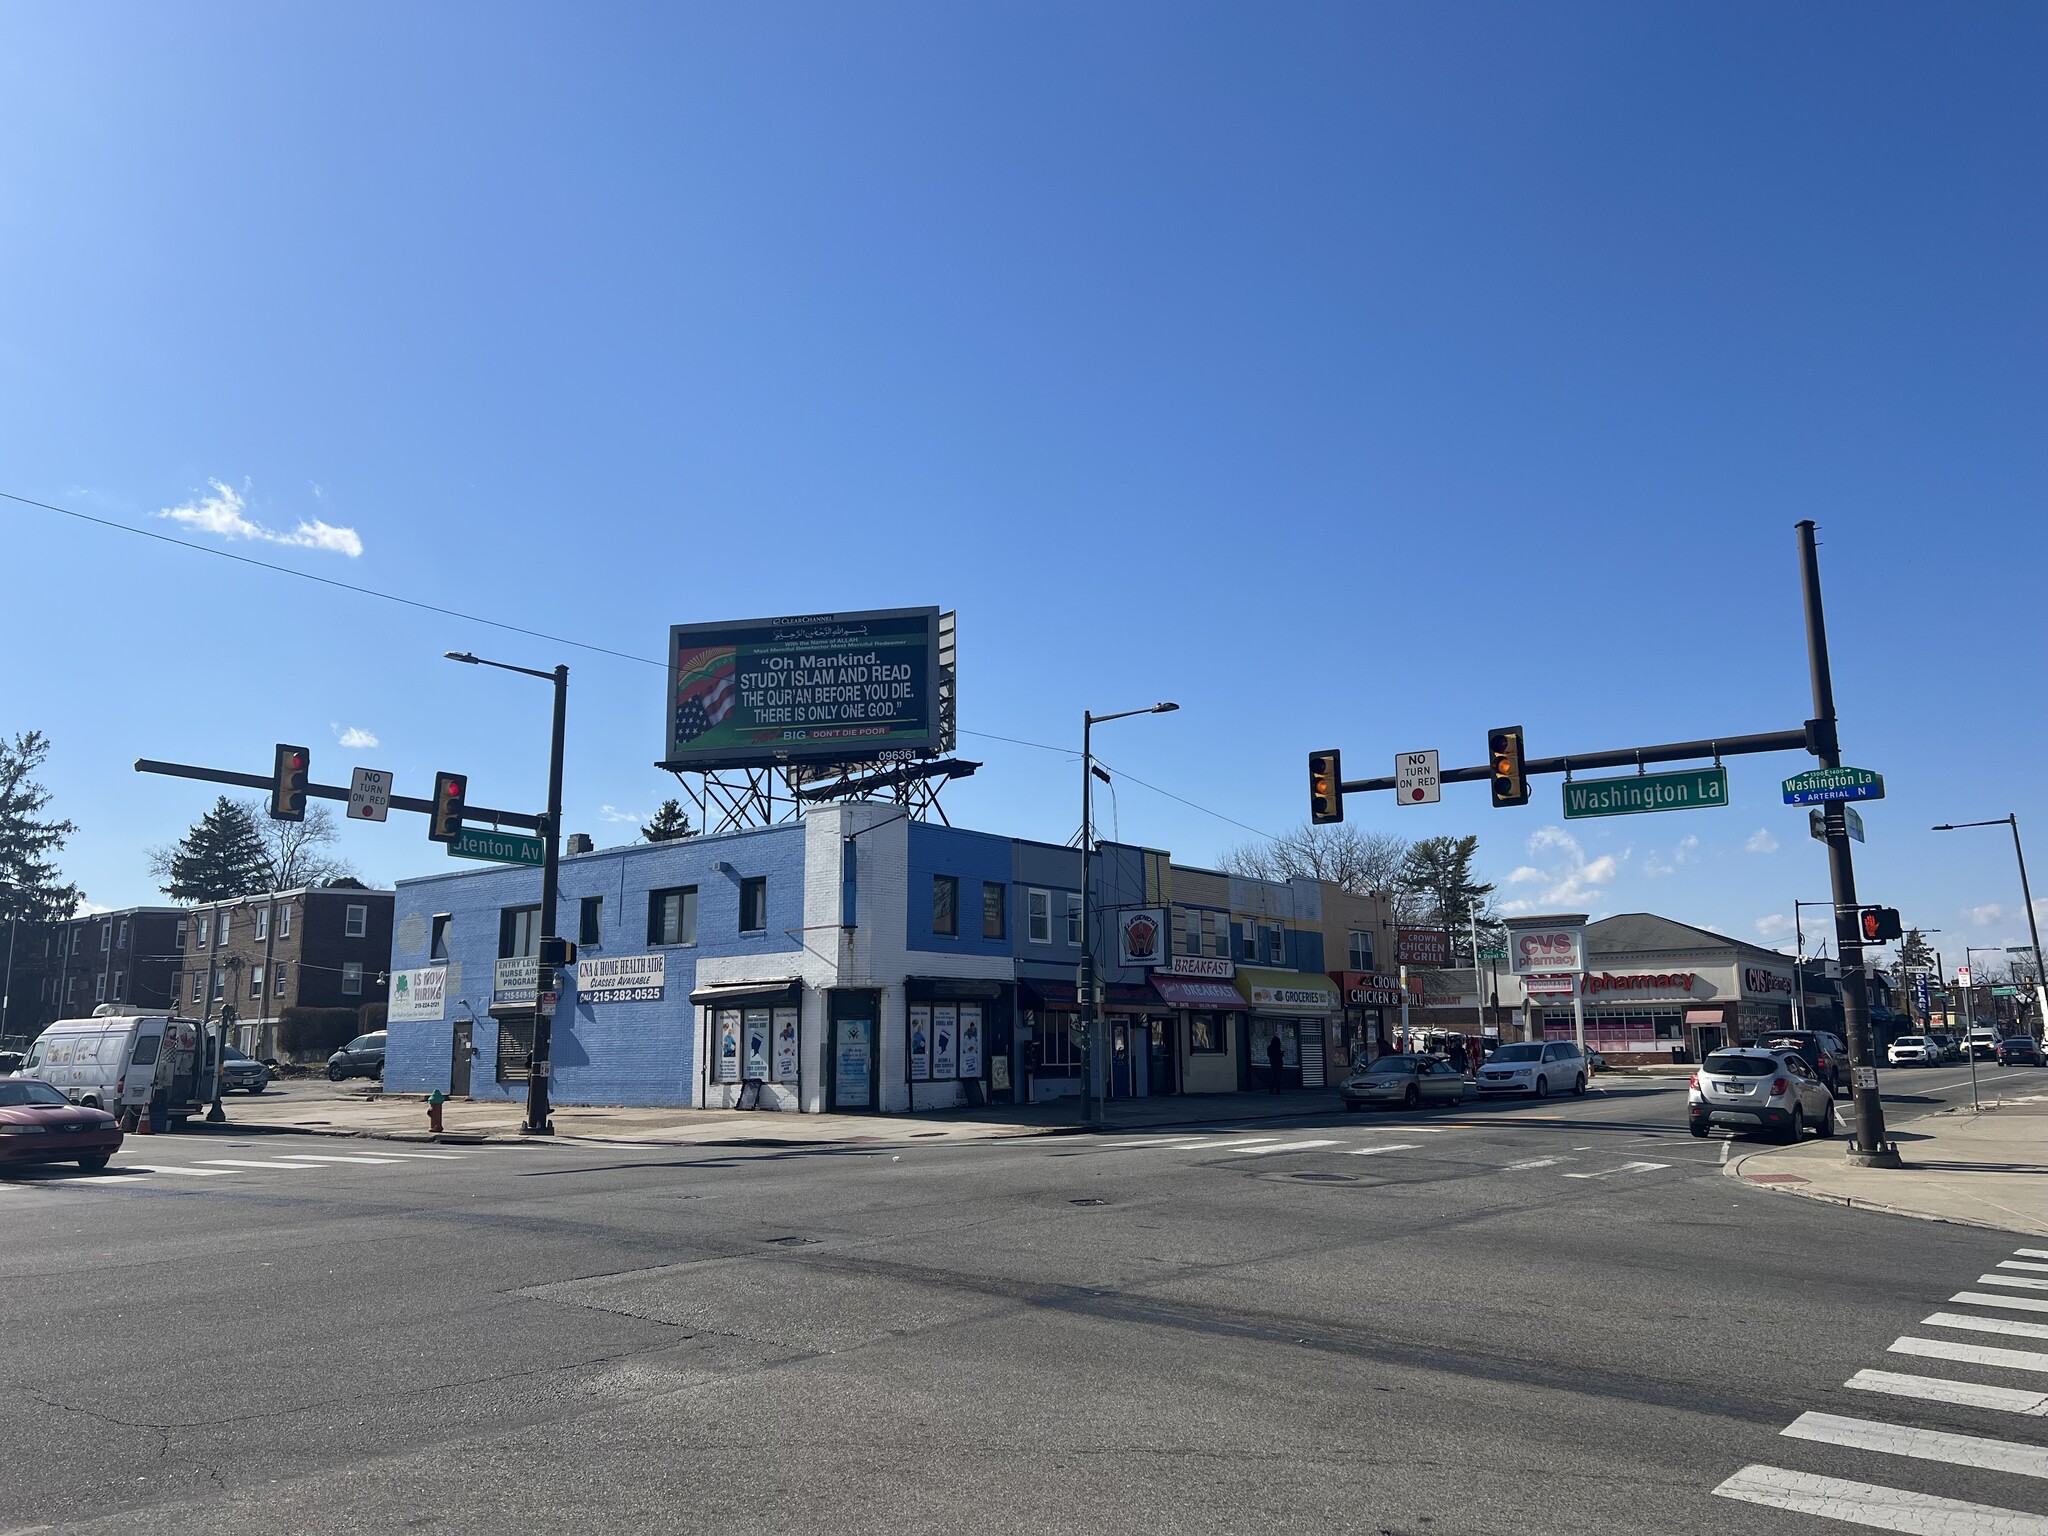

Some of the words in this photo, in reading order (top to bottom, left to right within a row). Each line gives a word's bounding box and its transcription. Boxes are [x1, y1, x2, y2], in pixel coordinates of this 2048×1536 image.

[800, 652, 881, 669] Mankind.
[740, 671, 787, 689] STUDY
[791, 668, 835, 687] ISLAM
[838, 666, 868, 684] AND
[872, 664, 911, 682] READ
[741, 691, 764, 707] THE
[766, 688, 812, 706] QUR'AN
[815, 685, 861, 703] BEFORE
[863, 684, 888, 700] YOU
[891, 682, 914, 698] DIE.
[754, 708, 792, 723] THERE
[794, 707, 806, 721] IS
[808, 705, 838, 720] ONLY
[840, 703, 865, 719] ONE
[783, 731, 806, 740] BIG
[813, 729, 841, 738] DON'T
[842, 728, 857, 736] DIE
[859, 727, 885, 736] POOR
[878, 750, 916, 761] 096361
[1408, 754, 1426, 765] NO
[364, 772, 381, 783] NO
[1405, 766, 1430, 777] TURN
[360, 783, 383, 794] TURN
[1400, 779, 1412, 788] ON
[1418, 777, 1436, 786] RED
[1785, 774, 1855, 792] Washington
[1859, 772, 1872, 784] La
[352, 793, 365, 802] ON
[369, 795, 386, 805] RED
[1570, 783, 1688, 808] Washington
[1698, 778, 1720, 799] La
[1793, 794, 1801, 802] S
[1807, 790, 1850, 801] ARTERIAL
[1857, 787, 1866, 795] N
[521, 843, 539, 860] Av
[1408, 934, 1437, 942] CROWN
[1520, 933, 1571, 955] CVS
[1399, 943, 1445, 952] CHICKEN
[1399, 951, 1409, 960] &
[1413, 952, 1445, 962] GRILL
[1519, 955, 1576, 968] pharmacy
[499, 961, 521, 973] ENTRY
[522, 959, 539, 971] LEVE
[580, 962, 593, 977] CNA
[594, 962, 599, 976] &
[600, 961, 619, 976] HOME
[620, 958, 646, 974] HEALTH
[646, 957, 664, 972] AIDE
[1174, 958, 1229, 975] BREAKFAST
[413, 973, 422, 986] IS
[423, 971, 443, 986] NOW
[500, 969, 523, 978] NURSE
[525, 968, 538, 977] AID
[590, 978, 616, 988] CLASSES
[617, 976, 651, 986] AVAILABLE
[1373, 976, 1401, 989] CROWN
[1528, 980, 1569, 990] FOODMART
[414, 987, 442, 1001] HIRING
[503, 991, 538, 1000] 215-549-16
[1181, 984, 1236, 997] BREAKFAST
[1285, 991, 1319, 1003] GROCERIES
[1915, 974, 1927, 1009] DOLLAR
[580, 993, 591, 1003] CALL
[1351, 989, 1389, 1004] CHICKEN
[1391, 993, 1399, 1004] &
[1407, 993, 1424, 1006] RILL
